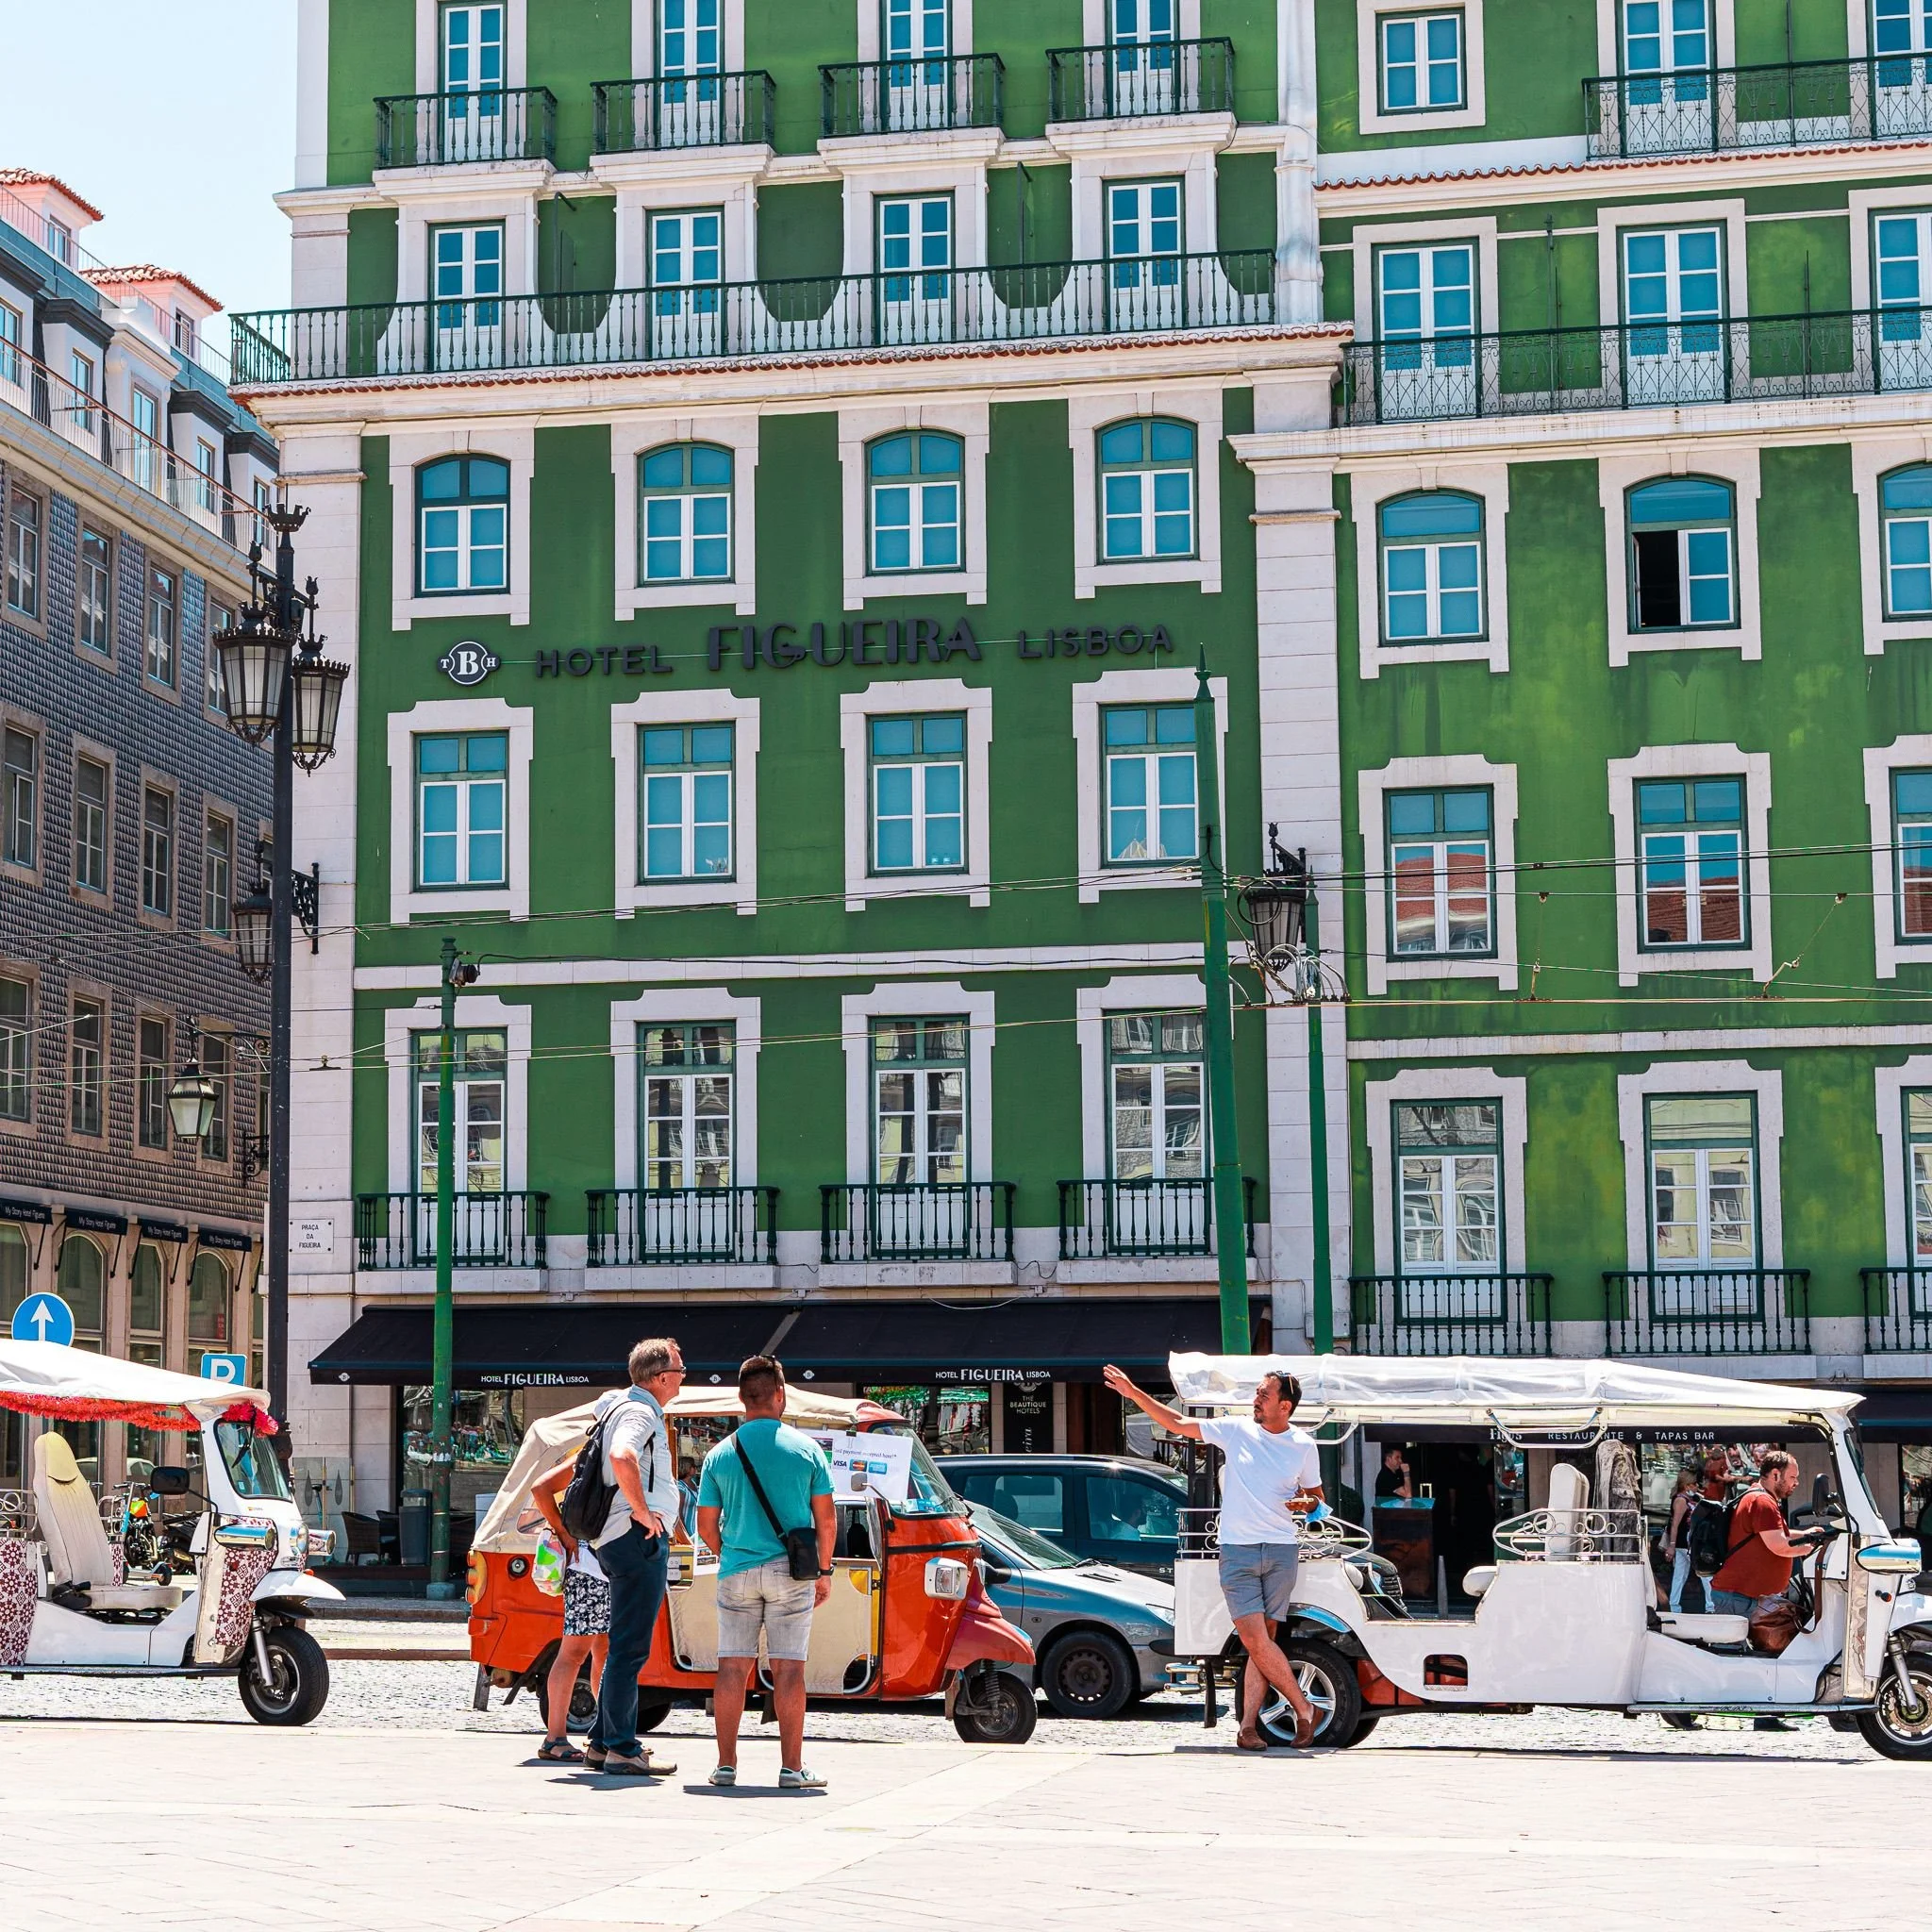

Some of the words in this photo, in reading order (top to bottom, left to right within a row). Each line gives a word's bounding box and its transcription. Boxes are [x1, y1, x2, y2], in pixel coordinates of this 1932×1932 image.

[536, 645, 673, 677] HOTEL
[708, 617, 982, 671] FIGUEIRA
[1018, 625, 1174, 658] LISBOA
[210, 1358, 236, 1383] P
[504, 1373, 566, 1385] FIGUEIRA
[960, 1369, 1024, 1381] FIGUEIRA
[1023, 1427, 1033, 1453] eira
[1636, 1431, 1642, 1440] &
[1655, 1431, 1688, 1440] TAPAS
[1694, 1431, 1715, 1440] BAR
